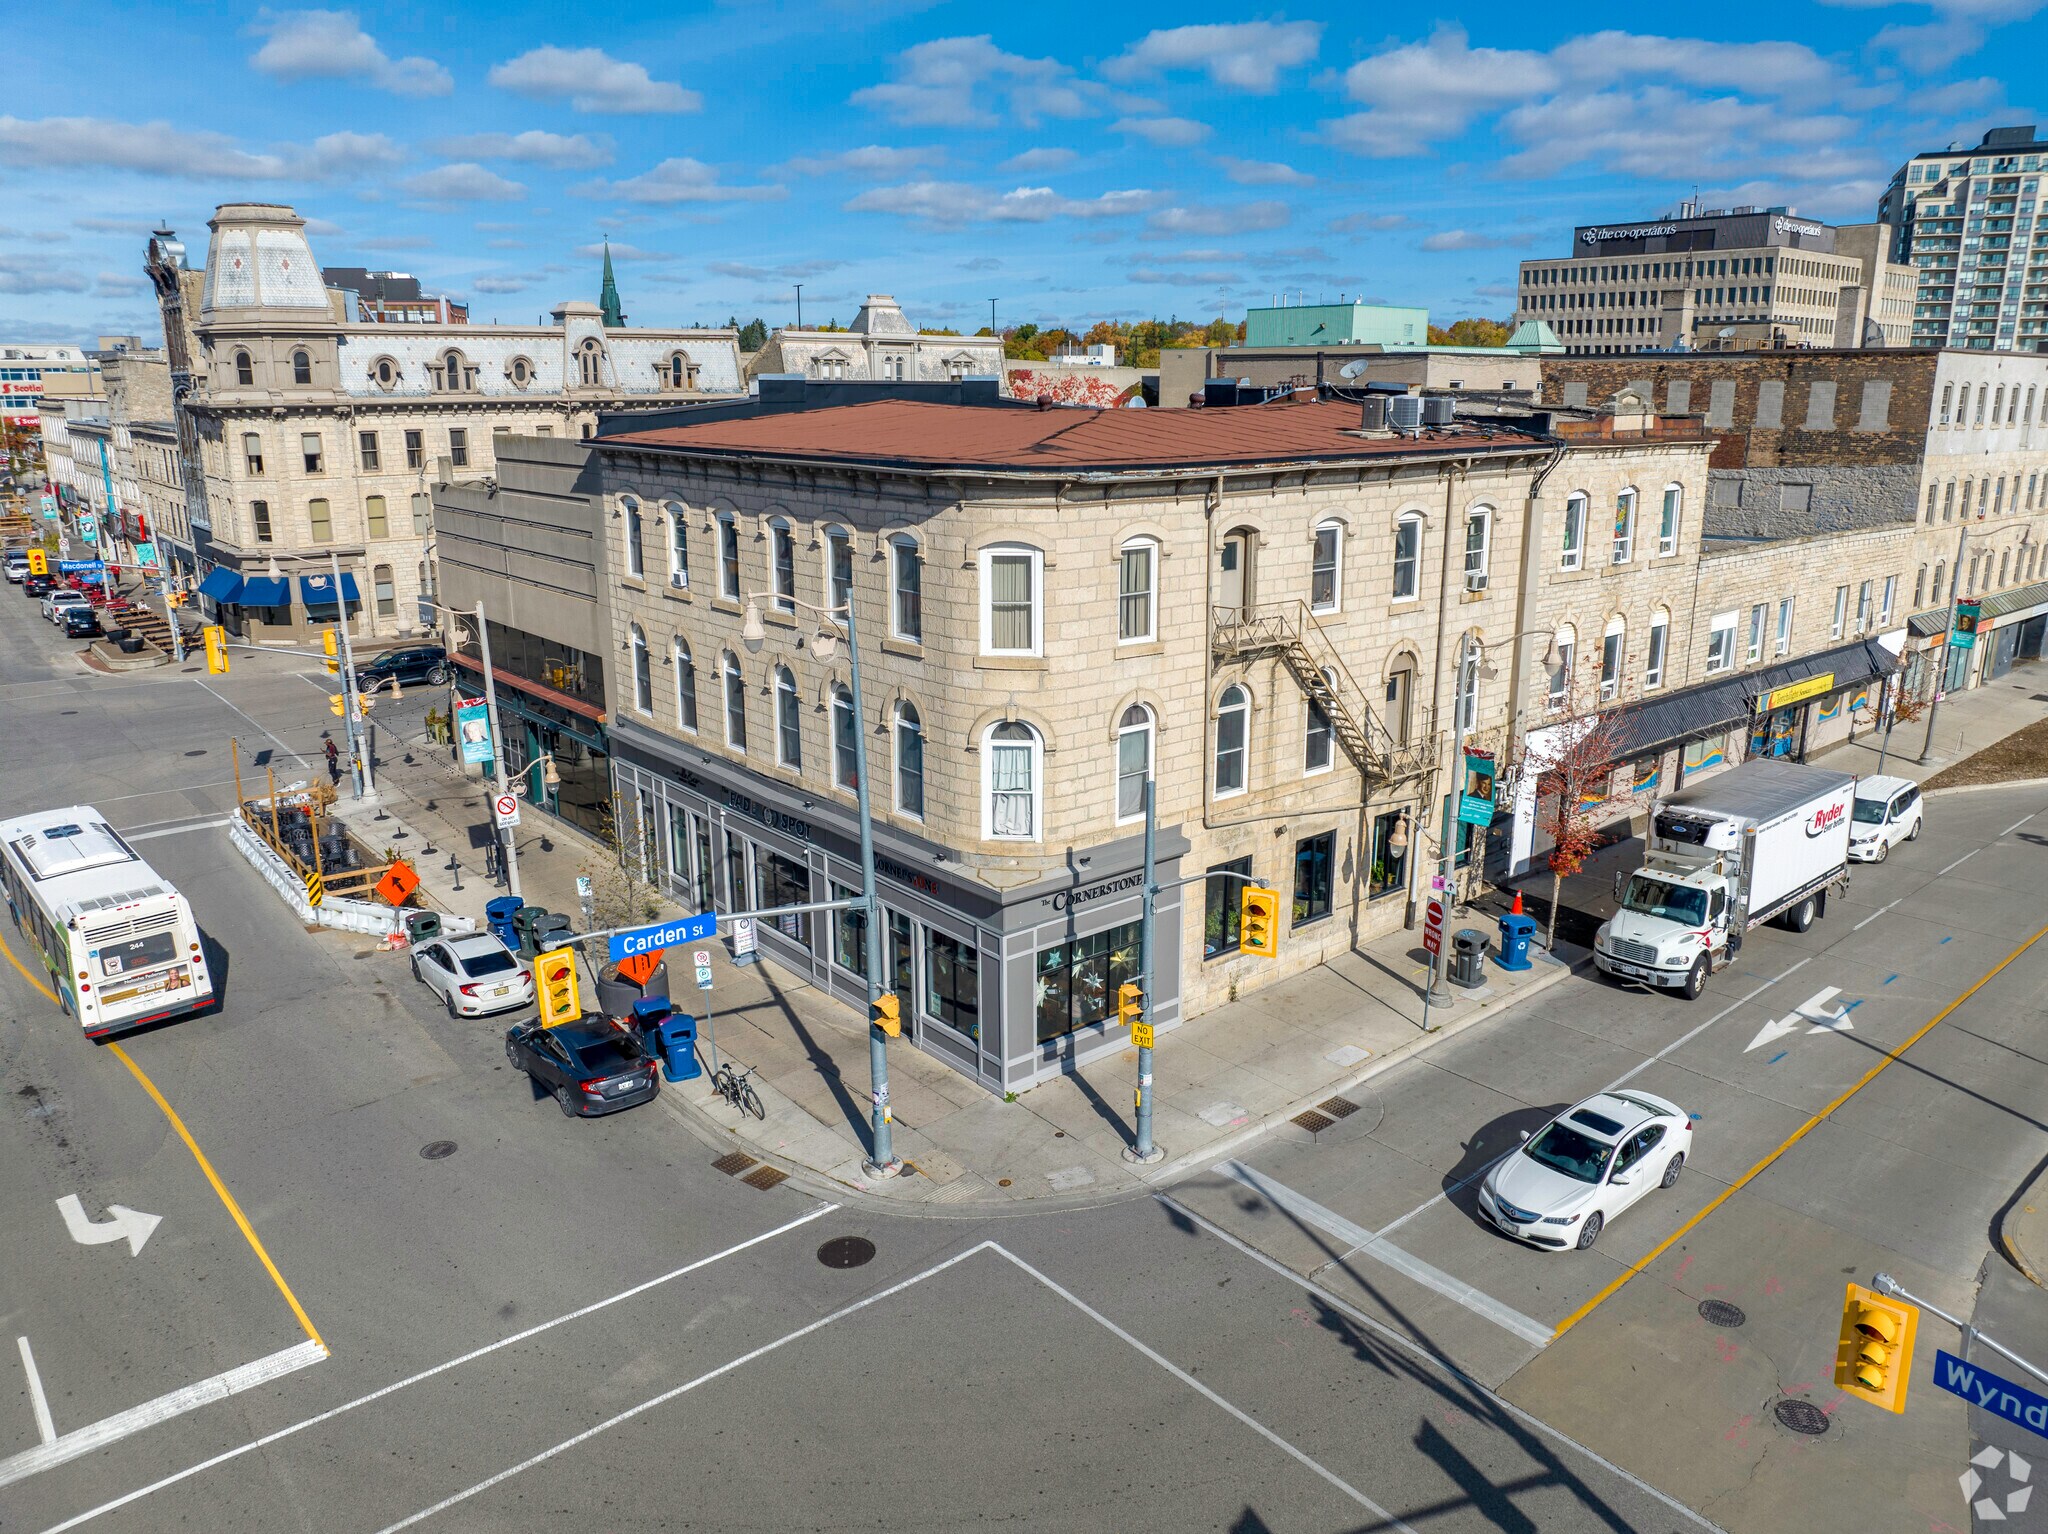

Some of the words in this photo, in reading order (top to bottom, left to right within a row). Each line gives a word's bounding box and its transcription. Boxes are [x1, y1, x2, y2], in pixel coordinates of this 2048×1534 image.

[1597, 228, 1613, 240] the
[62, 562, 97, 570] Macdonell
[1814, 803, 1845, 829] Ryder
[780, 813, 812, 840] SPOT
[1041, 899, 1051, 907] The
[623, 926, 686, 954] Carden
[692, 924, 704, 937] St
[1425, 926, 1441, 942] WRONG
[129, 941, 144, 951] 244
[1426, 939, 1437, 951] WAY
[1137, 1026, 1148, 1035] NO
[1134, 1034, 1151, 1045] EXIT
[1947, 1360, 2048, 1431] Wynd
